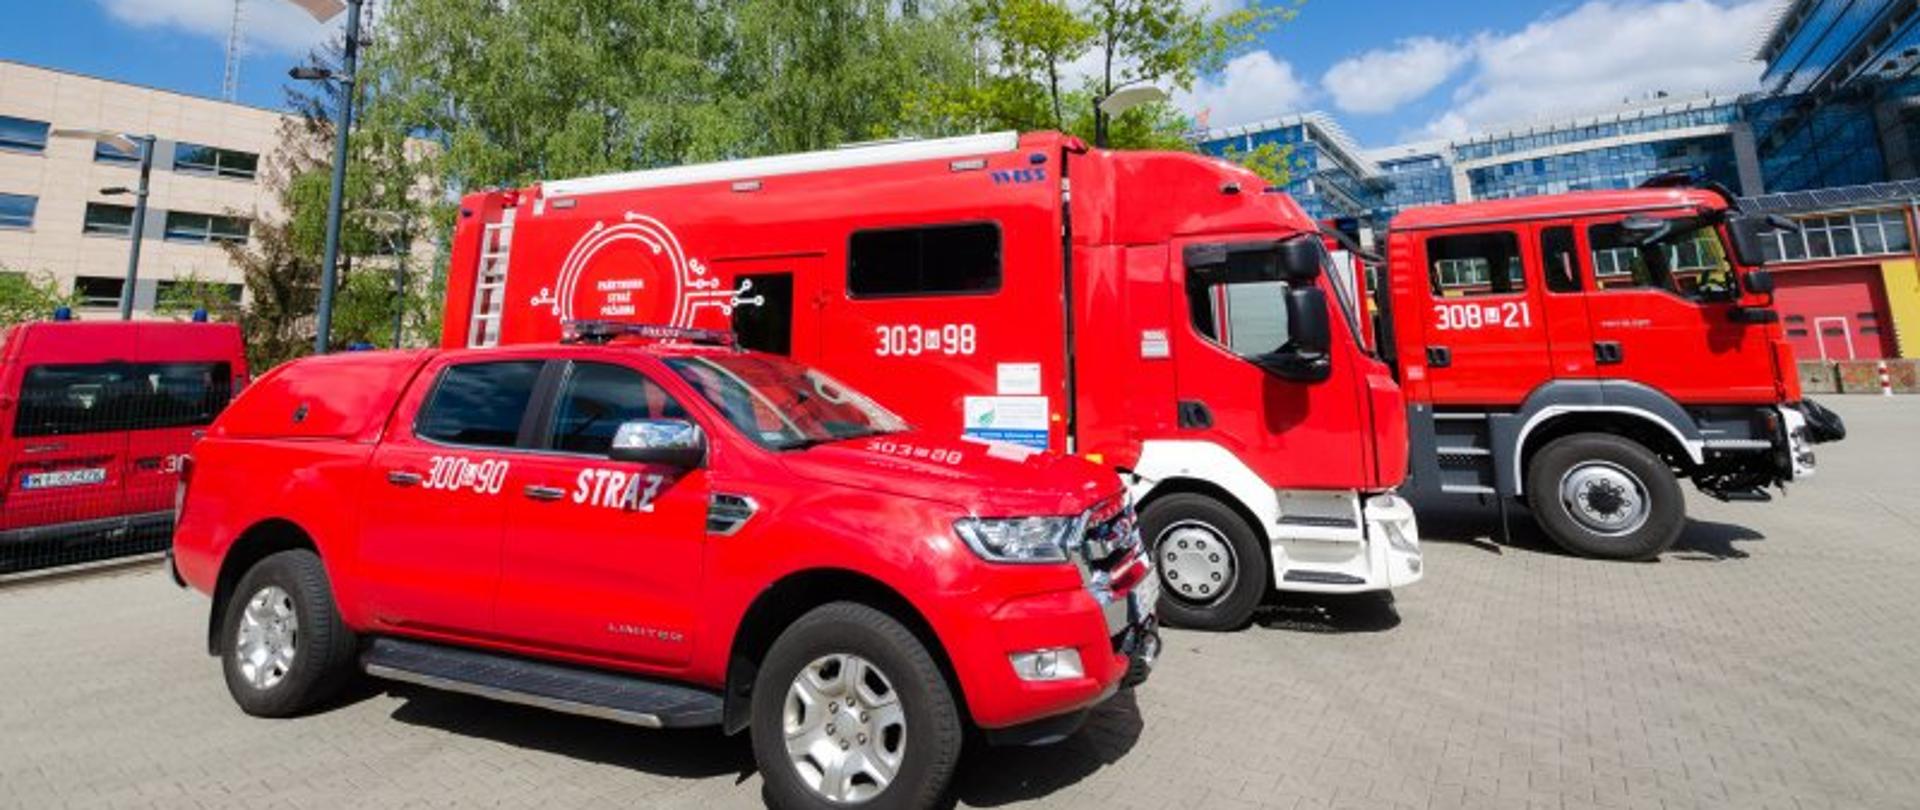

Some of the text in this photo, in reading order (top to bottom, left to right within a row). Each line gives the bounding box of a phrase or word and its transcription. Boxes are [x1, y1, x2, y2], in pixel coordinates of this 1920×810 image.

[1434, 304, 1482, 330] 308
[1502, 302, 1531, 328] 21
[876, 325, 922, 356] 303
[943, 324, 976, 355] 98
[423, 456, 468, 490] 300
[475, 459, 509, 493] 90
